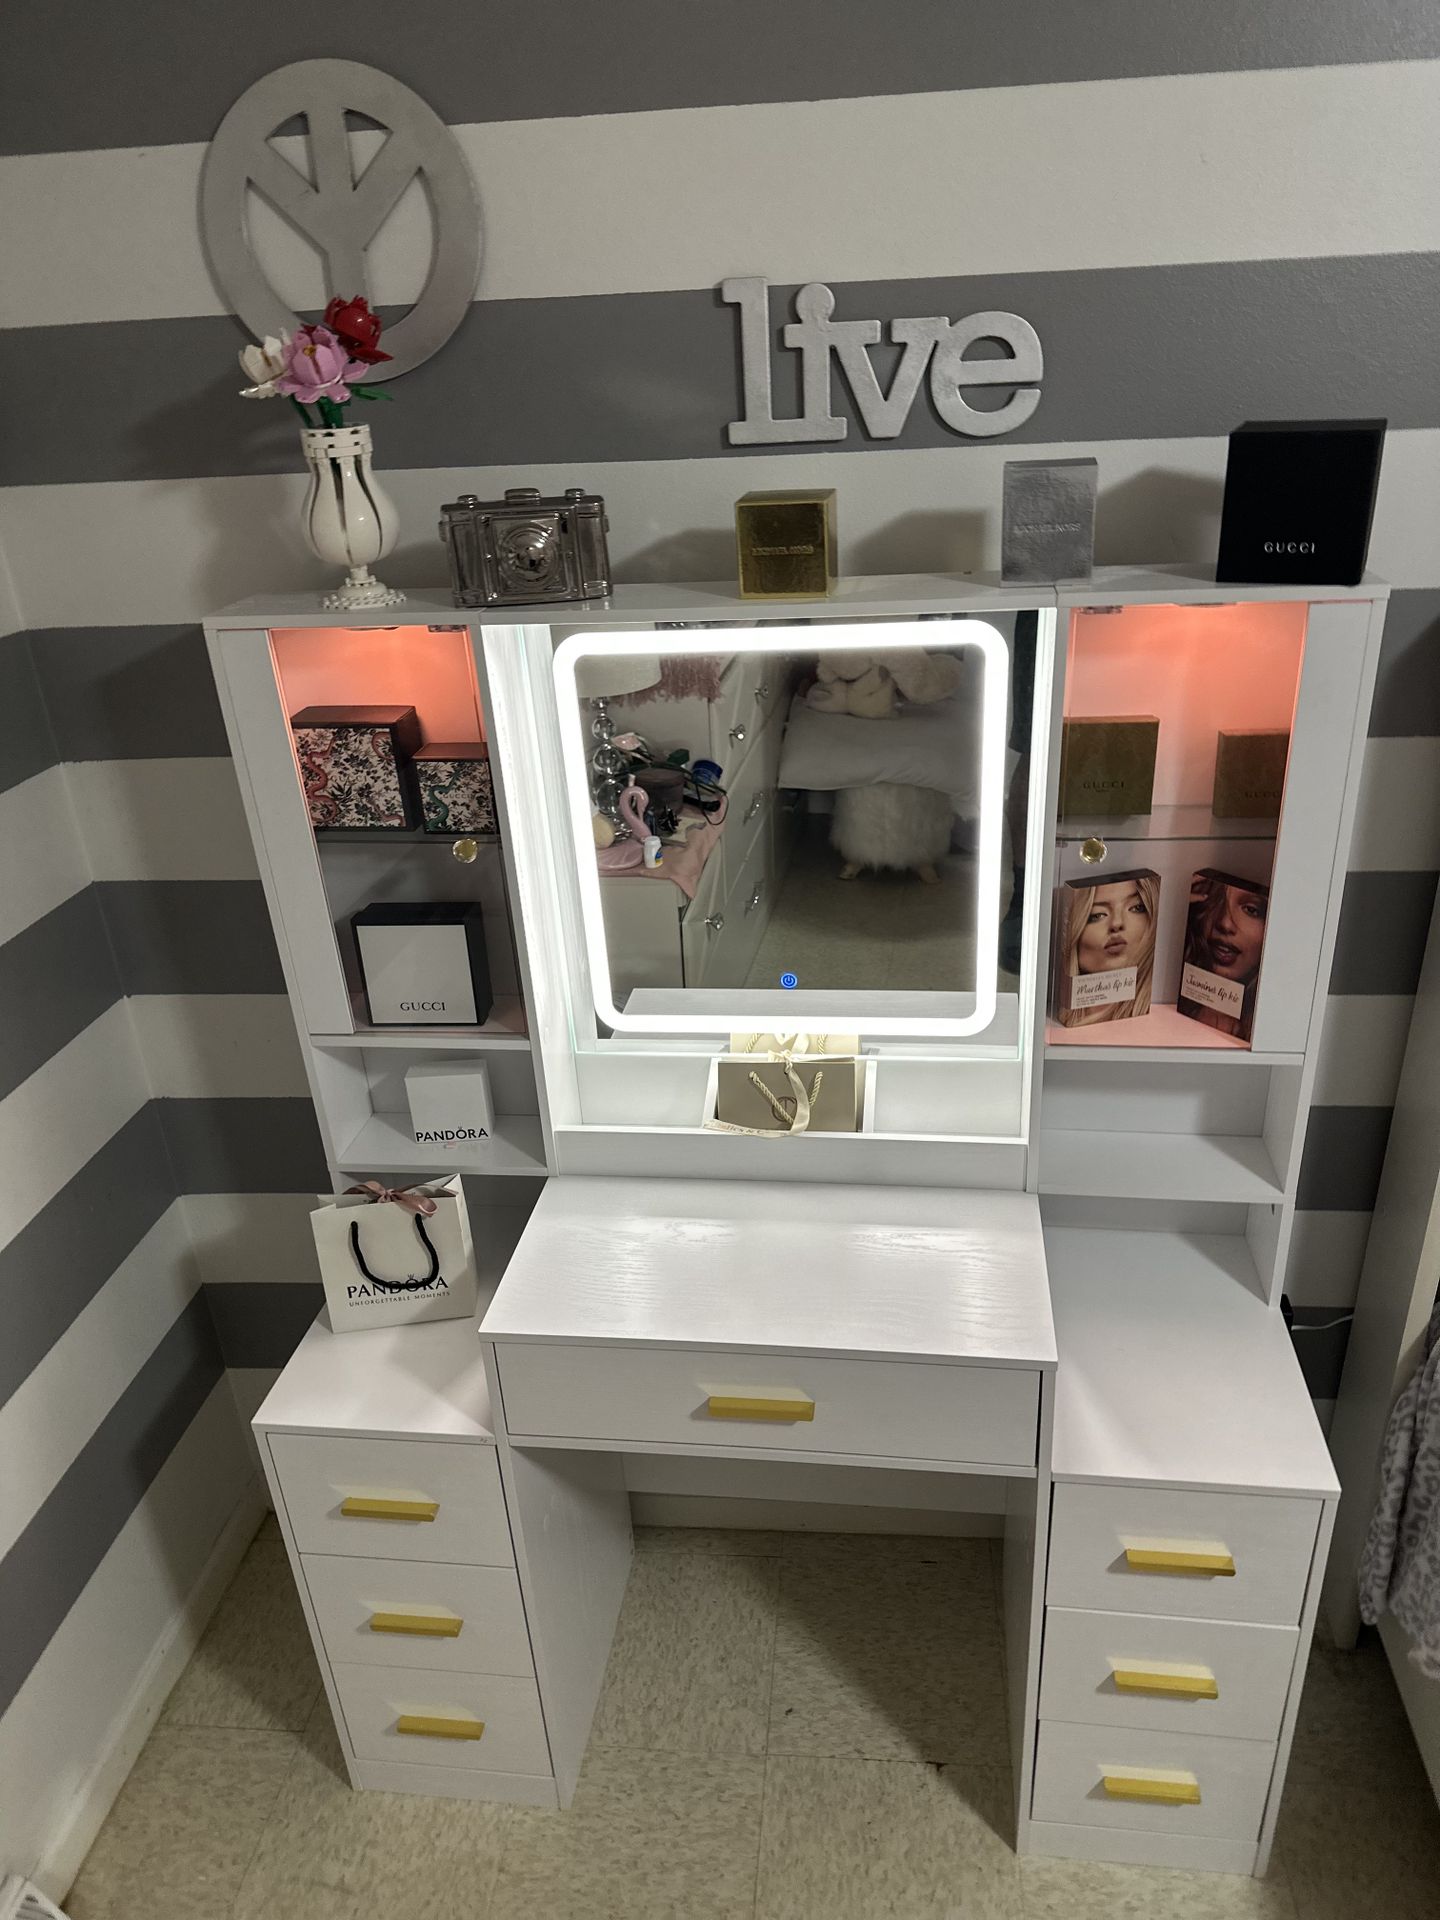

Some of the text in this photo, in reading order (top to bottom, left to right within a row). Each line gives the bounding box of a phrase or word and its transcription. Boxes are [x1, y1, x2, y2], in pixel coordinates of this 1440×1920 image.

[721, 277, 1044, 445] live
[1264, 541, 1315, 554] GUCCI
[1217, 987, 1228, 1001] lip
[400, 1001, 446, 1012] GUCCI
[415, 1127, 489, 1142] PANDORA
[347, 1275, 448, 1299] PANDORA
[349, 1291, 450, 1307] UNFORGETTABLE MOMENTS
